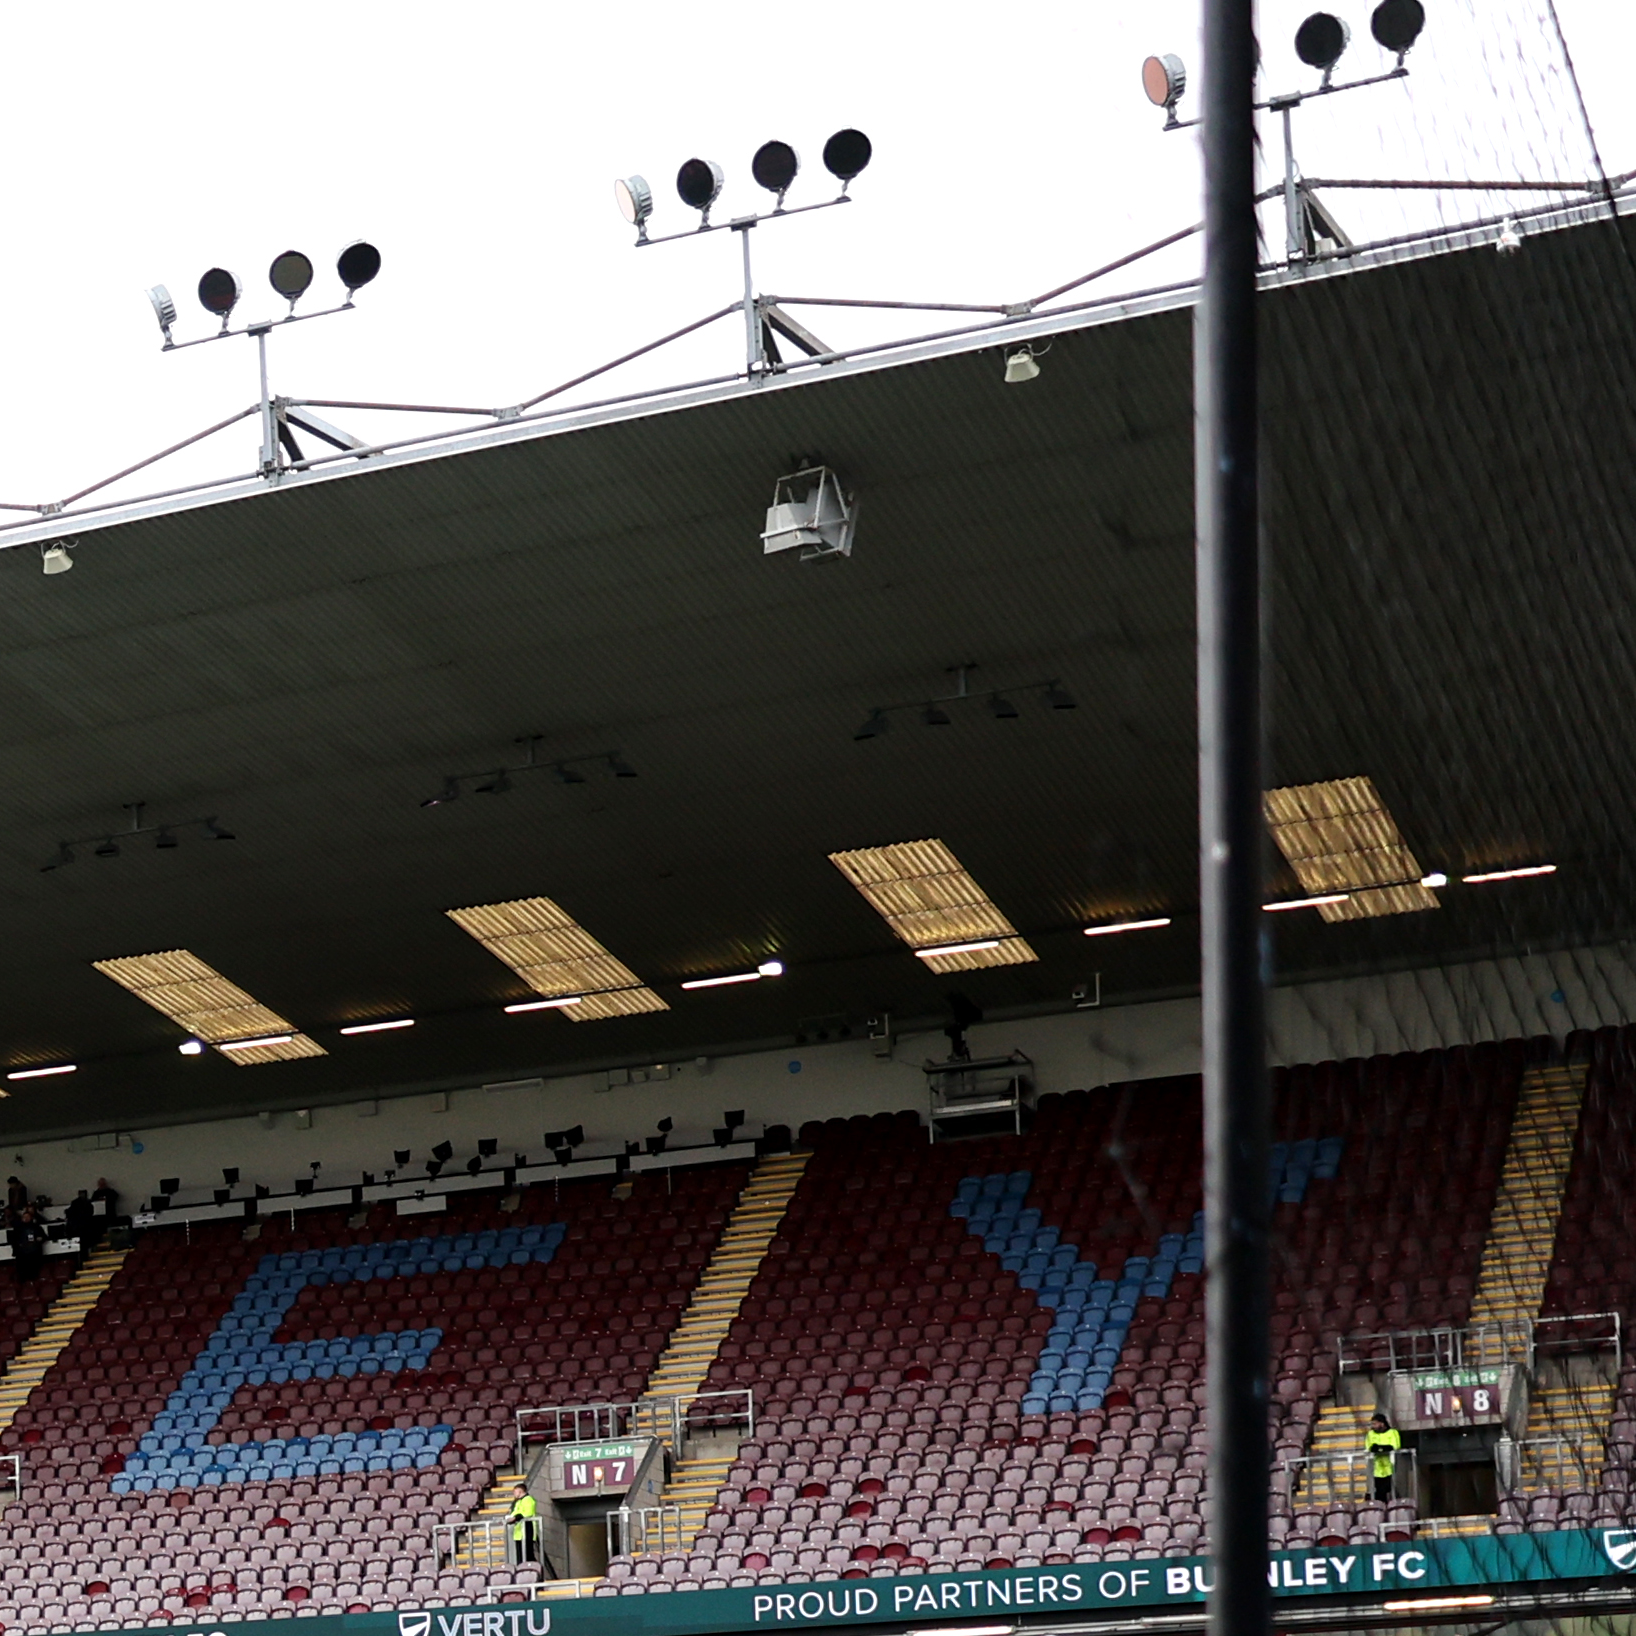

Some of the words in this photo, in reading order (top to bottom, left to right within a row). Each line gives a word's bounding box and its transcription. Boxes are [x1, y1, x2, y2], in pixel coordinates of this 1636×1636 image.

[1425, 1393, 1442, 1415] N
[1473, 1389, 1489, 1411] 8
[595, 1448, 602, 1457] 7
[572, 1464, 587, 1485] N
[612, 1461, 626, 1481] 7
[754, 1588, 878, 1622] PROUD
[894, 1573, 1082, 1612] PARTNERS
[1098, 1569, 1150, 1599] OF
[1374, 1551, 1426, 1582] FC
